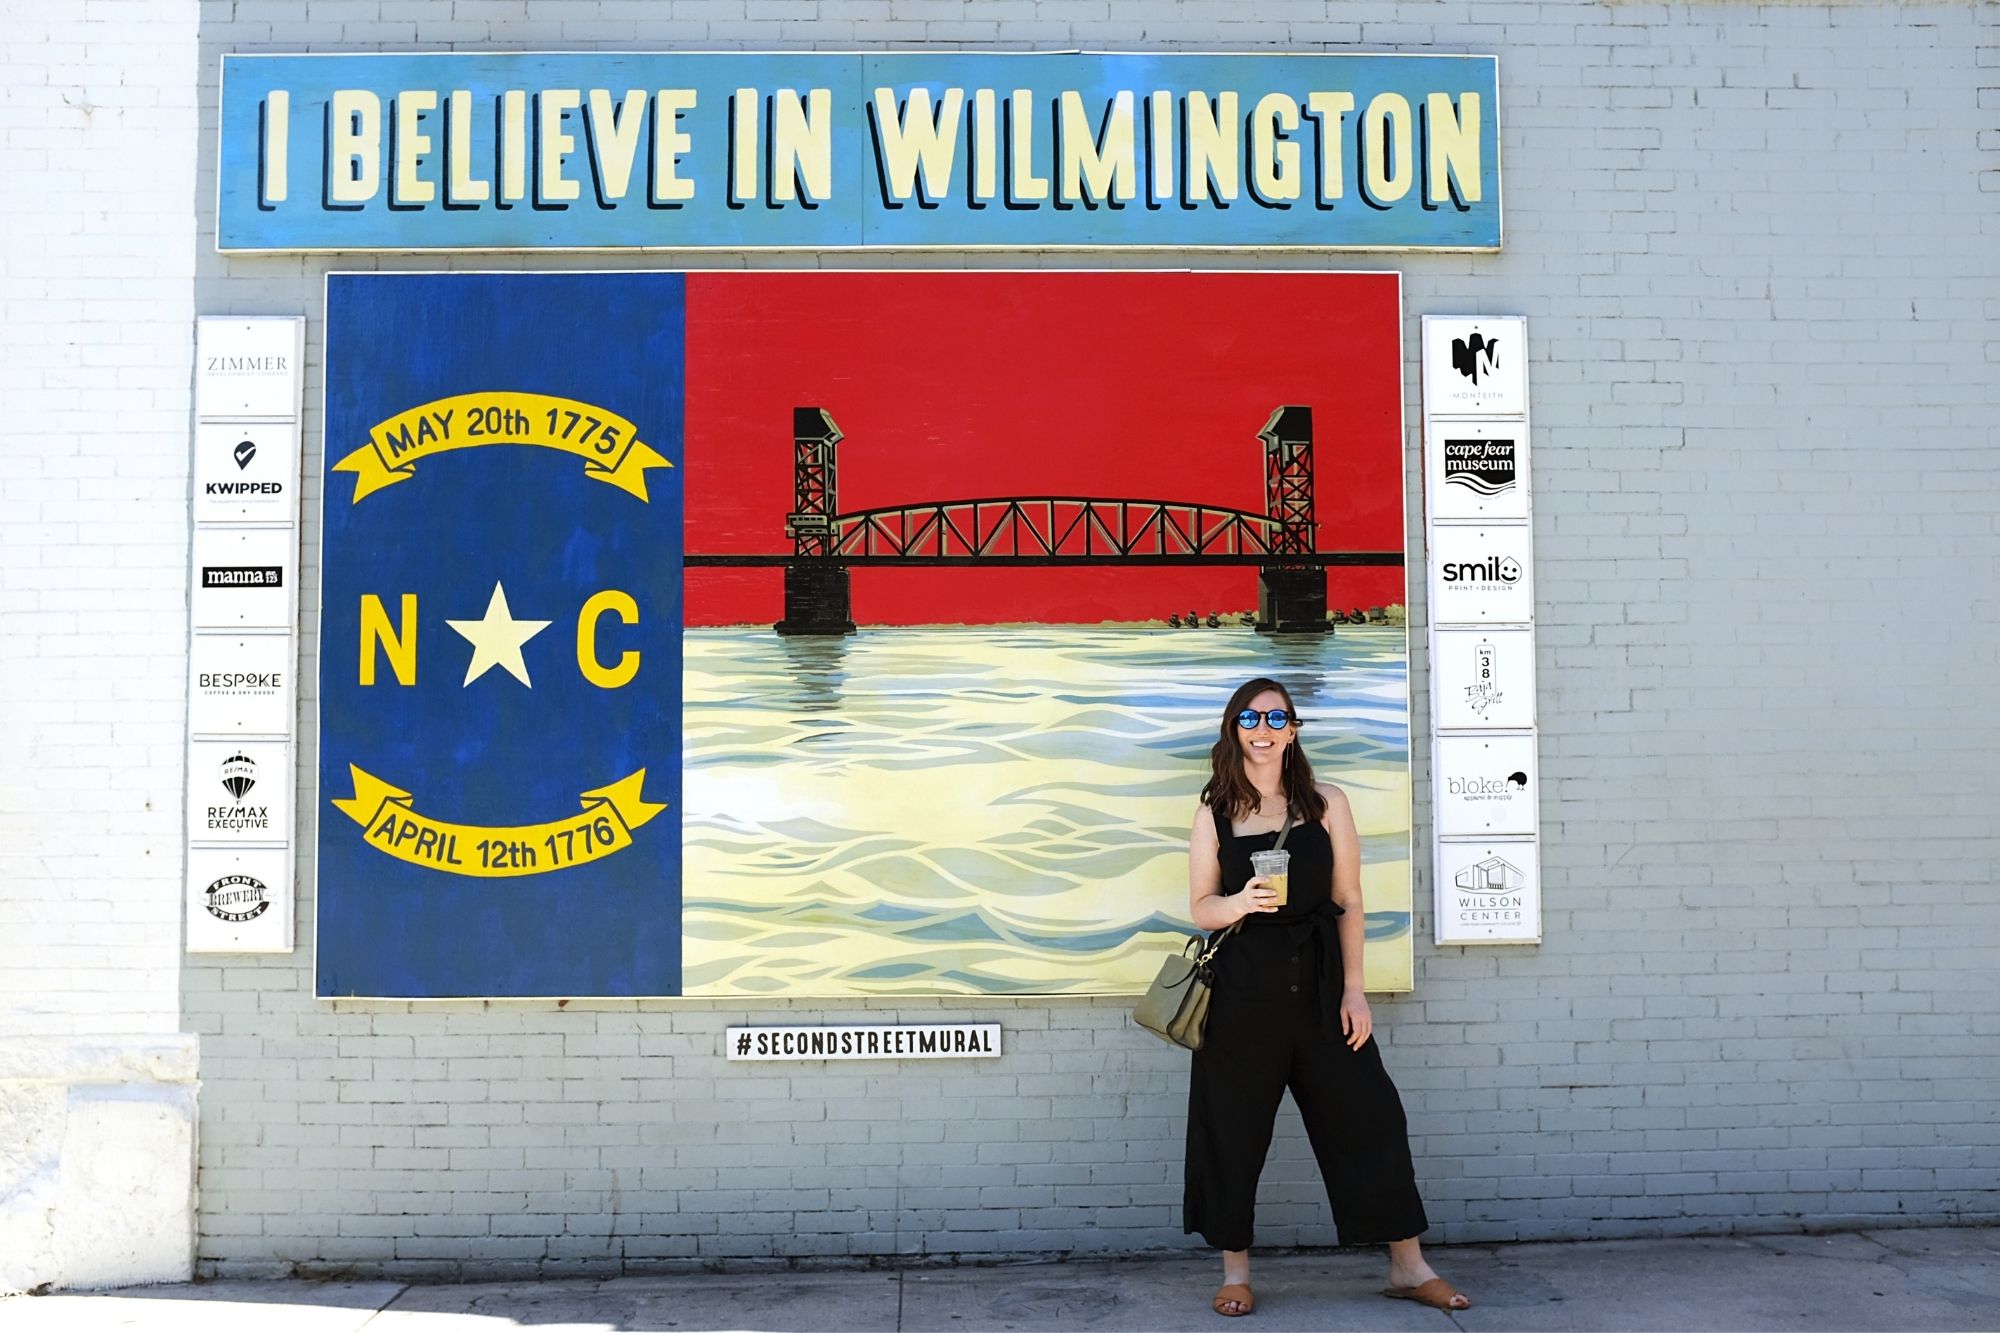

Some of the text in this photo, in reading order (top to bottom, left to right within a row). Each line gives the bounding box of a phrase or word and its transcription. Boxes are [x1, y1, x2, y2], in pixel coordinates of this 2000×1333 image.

[261, 87, 1481, 211] I BELIEVE IN WILMINGTON
[207, 356, 288, 371] ZIMMER
[385, 406, 621, 458] MAY 20th 1775
[1446, 441, 1513, 459] cape fear
[1447, 459, 1514, 470] museum
[205, 482, 282, 495] KWIPPED
[207, 570, 264, 584] manna
[359, 589, 641, 689] N C
[224, 766, 254, 775] RE/MAX
[207, 806, 268, 818] RE/MAX
[207, 819, 269, 829] EXECUTIVE
[373, 813, 616, 868] APRIL 12th 1776
[212, 876, 262, 890] FRONT
[208, 887, 266, 907] BREWERY
[1458, 896, 1521, 908] WILSON
[210, 906, 263, 921] STREET
[1460, 911, 1521, 921] CENTER
[737, 1030, 993, 1056] #SECONDSTREETMURAL
